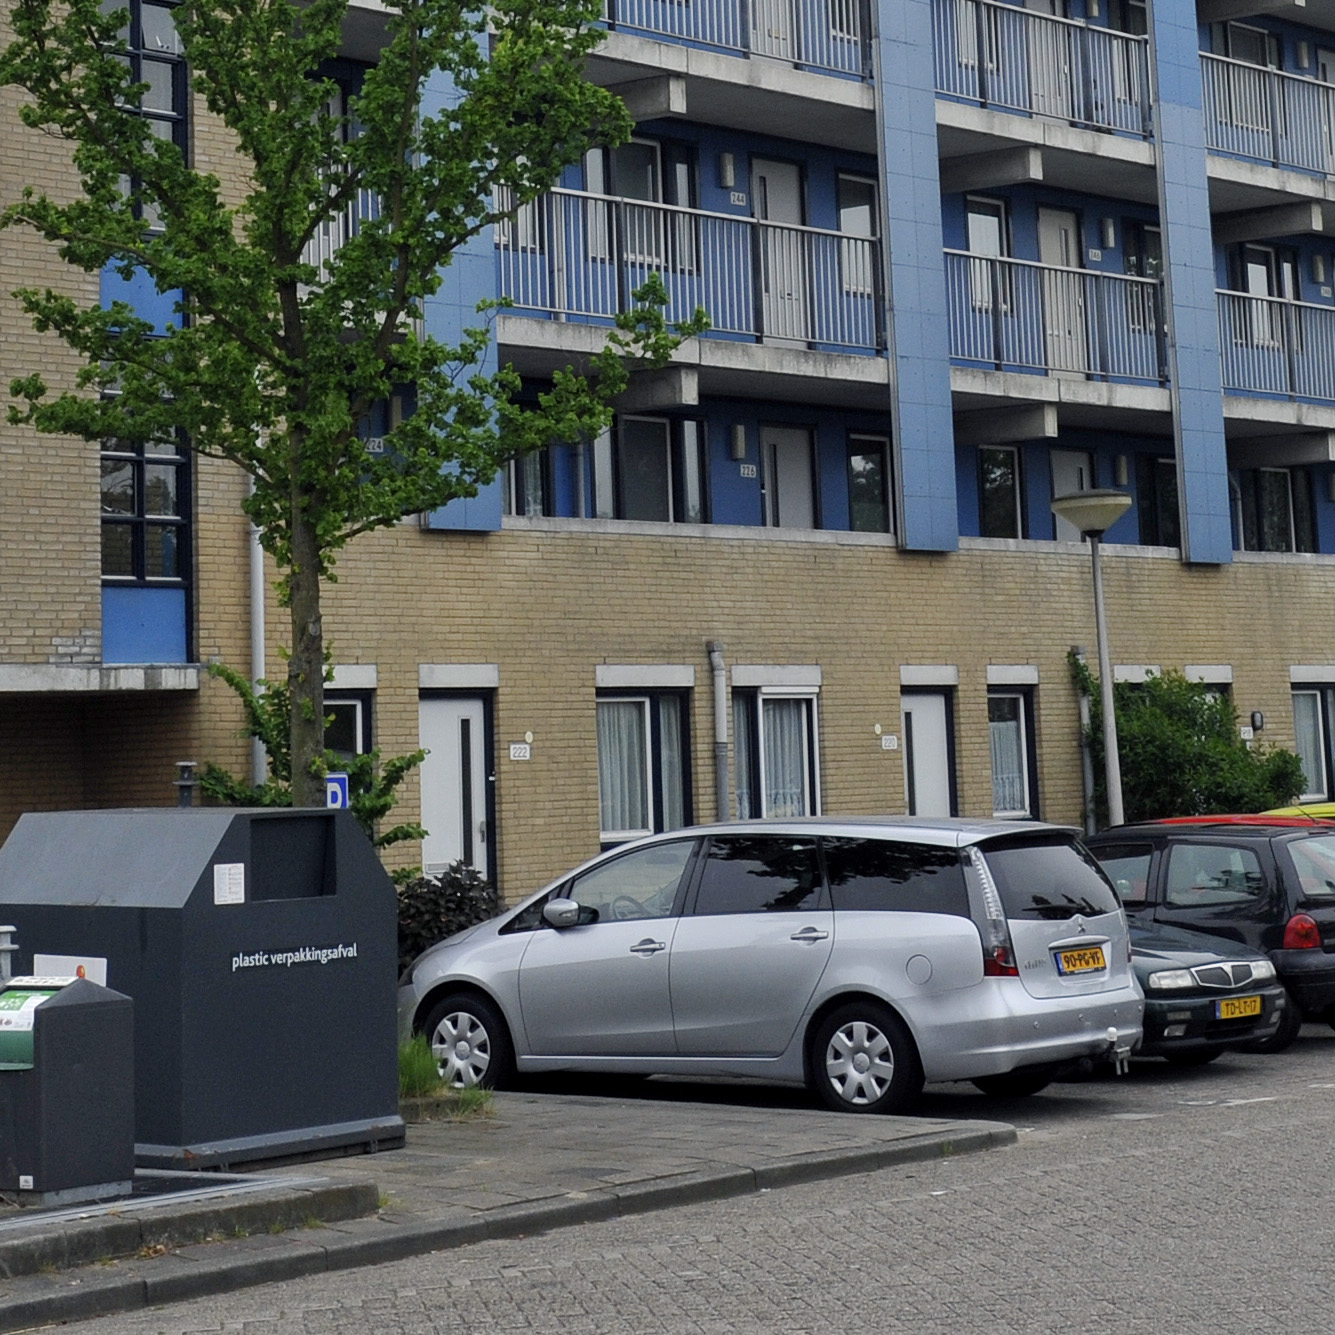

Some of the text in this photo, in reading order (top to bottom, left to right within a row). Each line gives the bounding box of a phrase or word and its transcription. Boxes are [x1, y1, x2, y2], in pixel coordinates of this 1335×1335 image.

[731, 193, 745, 204] 244
[741, 465, 756, 477] 226
[512, 747, 528, 758] 222
[232, 942, 358, 972] plastic verpakkingsafval
[1225, 999, 1257, 1016] TD-LT-17
